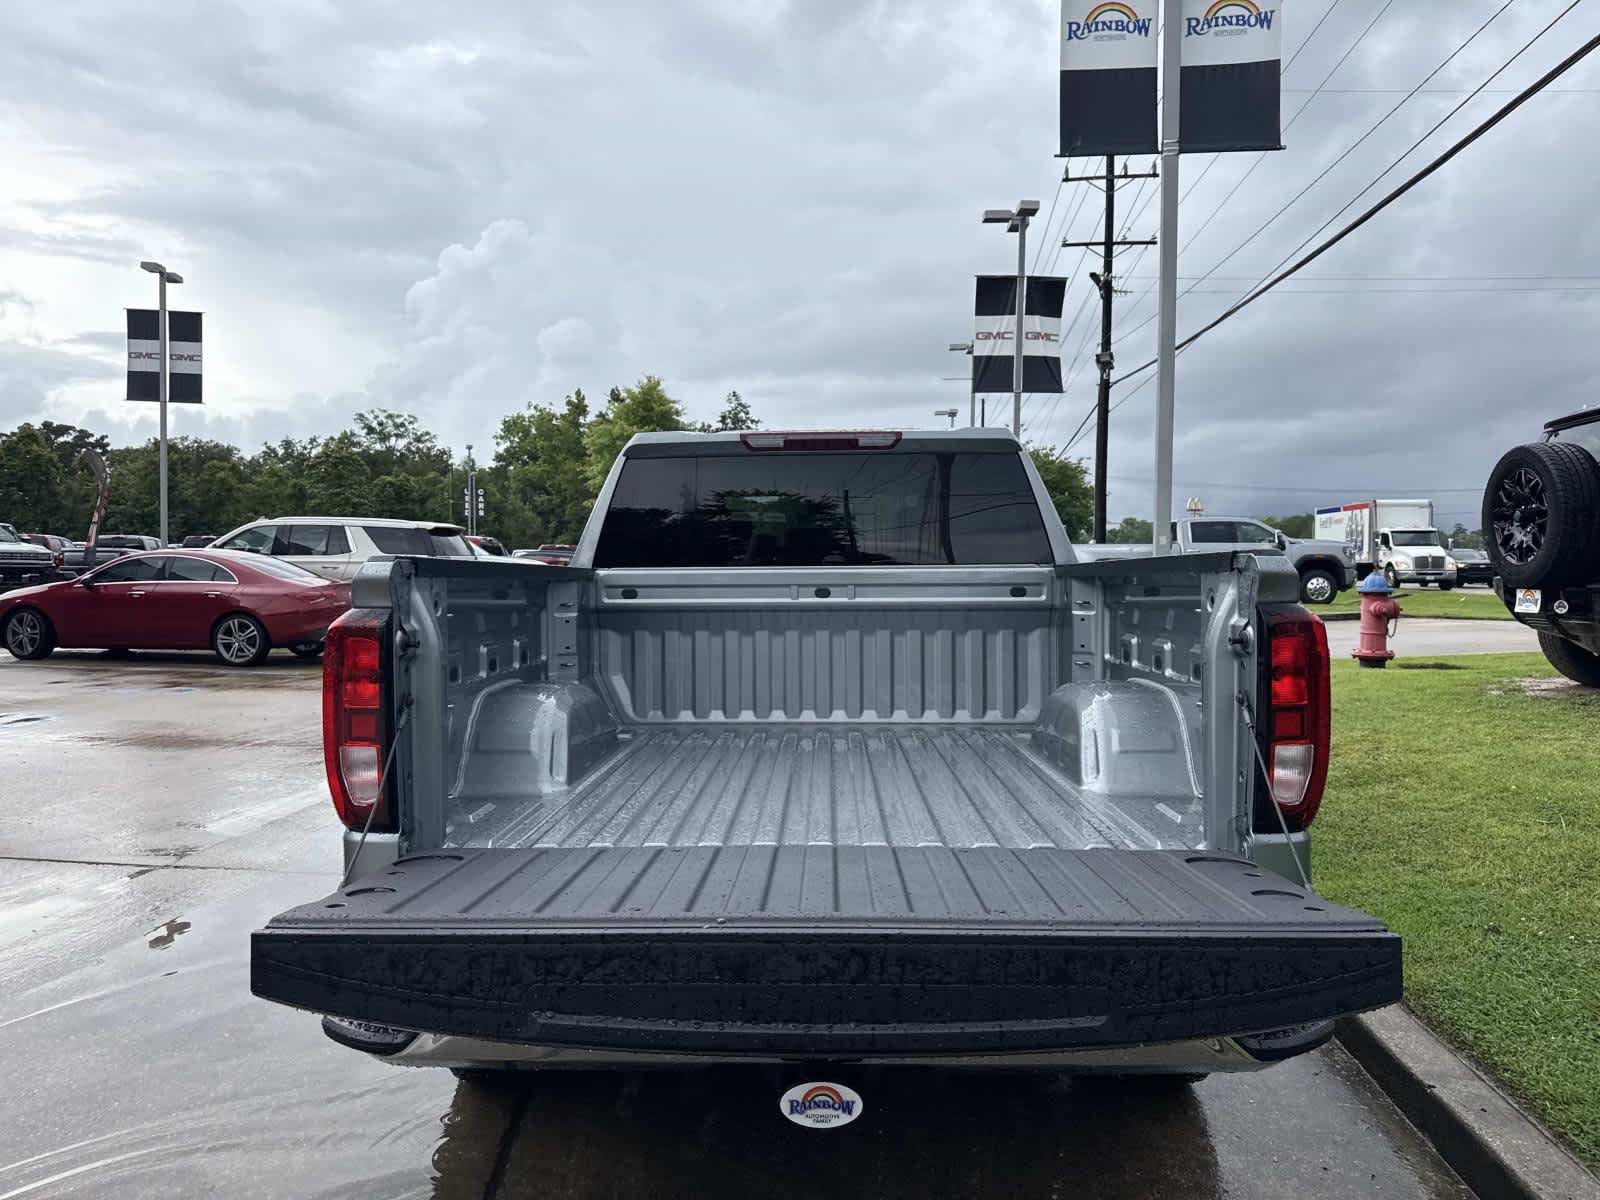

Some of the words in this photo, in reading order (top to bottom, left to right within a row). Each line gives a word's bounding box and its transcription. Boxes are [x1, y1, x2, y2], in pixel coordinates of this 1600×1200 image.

[1067, 17, 1152, 40] RAINBOW
[1185, 10, 1275, 37] RAINBOW
[976, 331, 1014, 340] GMC
[1025, 331, 1060, 342] GMC
[128, 352, 160, 360] GMC
[788, 1100, 856, 1116] RAINBOW
